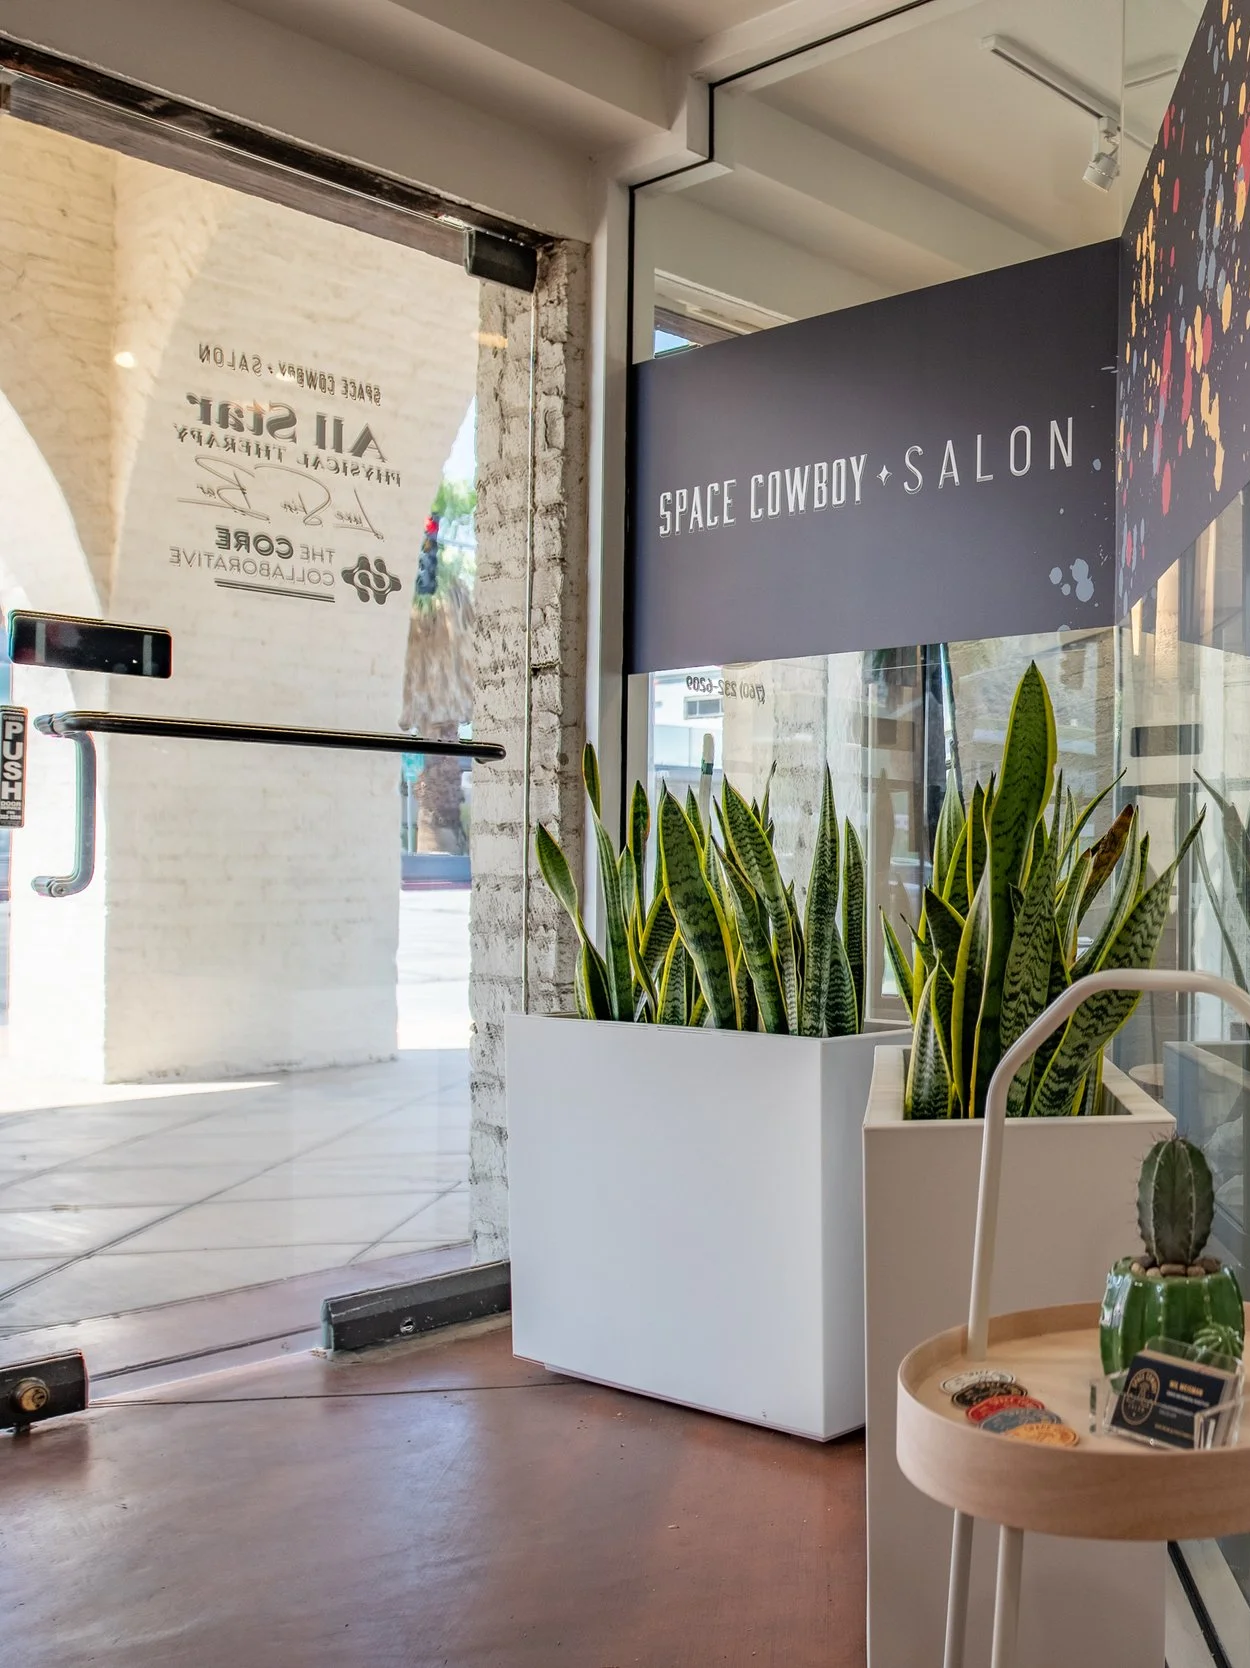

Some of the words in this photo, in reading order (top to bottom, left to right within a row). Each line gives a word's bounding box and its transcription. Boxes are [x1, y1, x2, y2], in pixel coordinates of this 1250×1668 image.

[658, 478, 739, 539] SPACE
[749, 452, 868, 522] COWBOY
[903, 416, 1075, 496] SALON
[2, 721, 23, 800] PUSH
